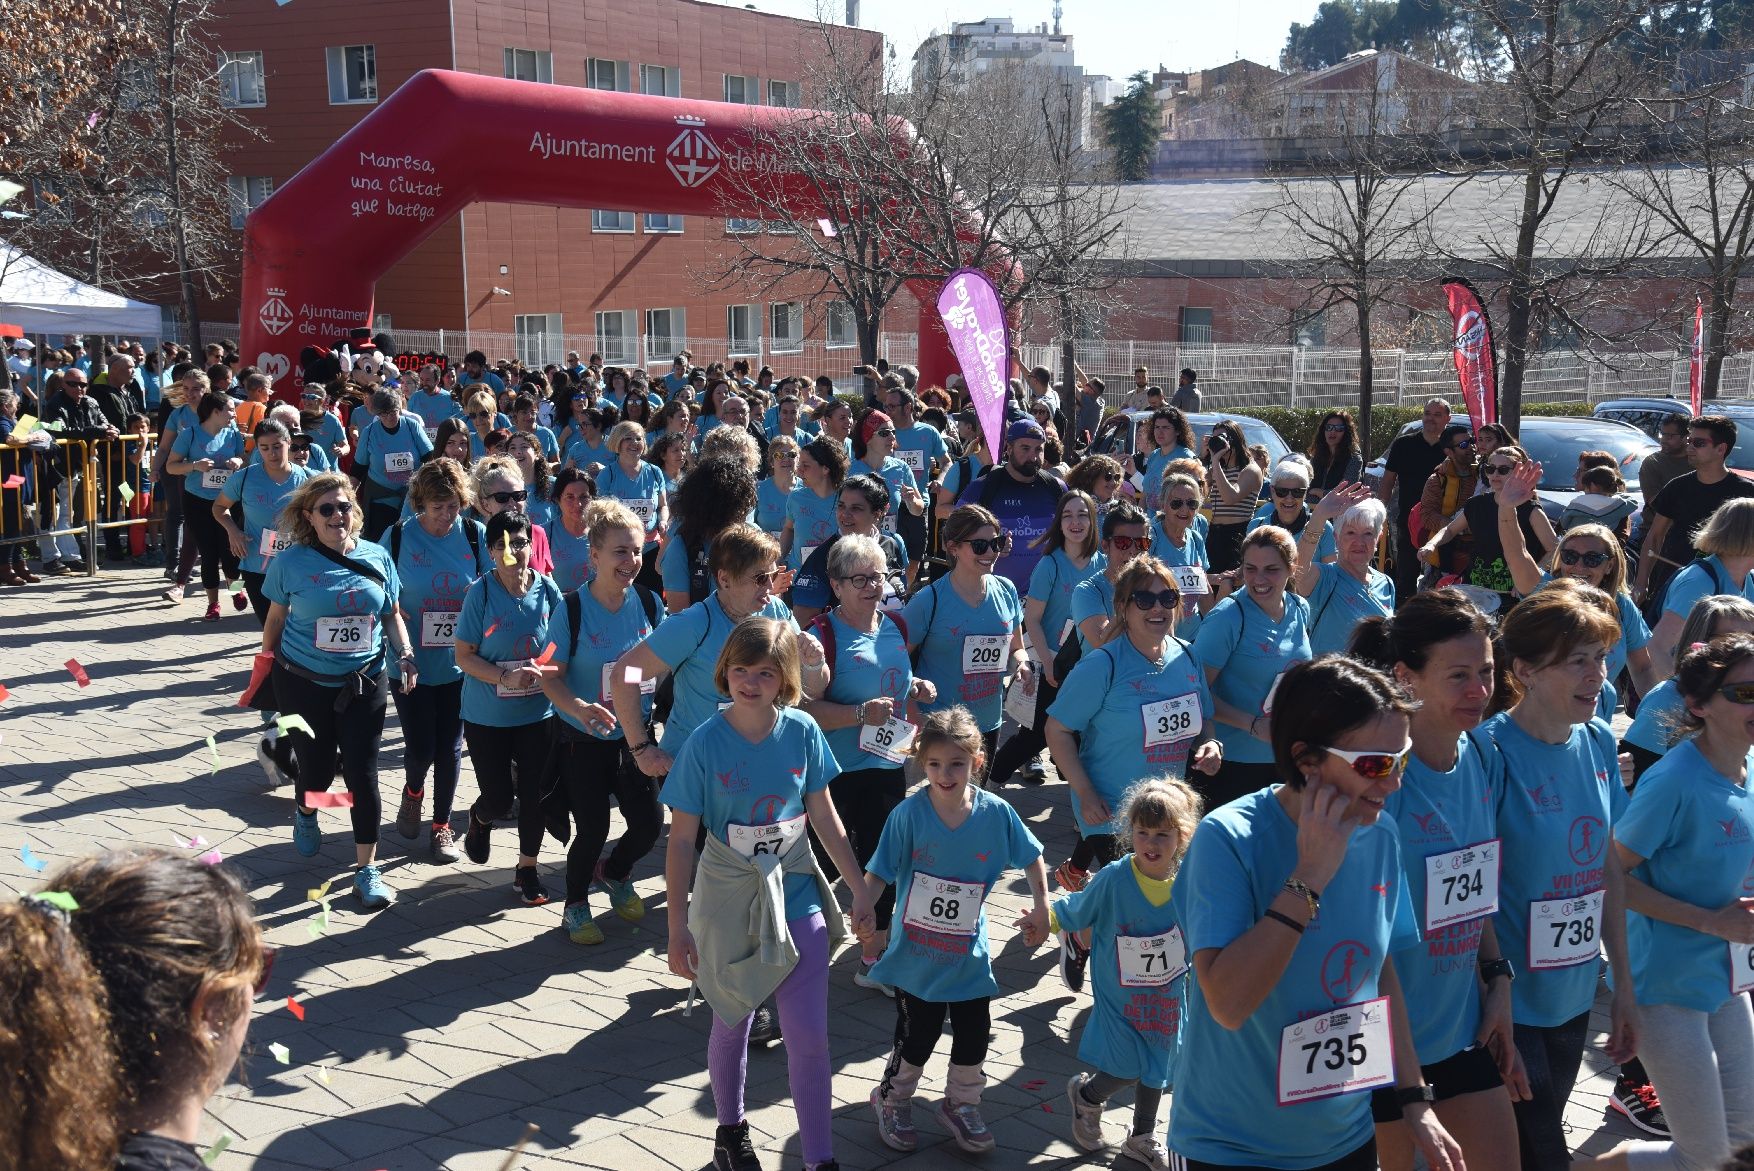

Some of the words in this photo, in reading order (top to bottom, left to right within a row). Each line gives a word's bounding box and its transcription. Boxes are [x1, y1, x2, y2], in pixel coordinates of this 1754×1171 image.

[529, 131, 656, 164] Ajuntament
[360, 151, 435, 174] Manresa,
[728, 150, 753, 172] de
[351, 176, 383, 191] una
[389, 176, 444, 197] ciutat
[351, 198, 379, 217] que
[387, 198, 435, 222] batega
[299, 303, 369, 322] Ajuntament
[298, 321, 317, 334] de
[391, 458, 408, 467] 169
[209, 474, 227, 484] 483
[1180, 575, 1200, 587] 137
[328, 627, 361, 643] 736
[971, 647, 1001, 663] 209
[1157, 711, 1191, 734] 338
[875, 727, 895, 747] 66
[753, 837, 785, 857] 67
[1441, 868, 1484, 906] 734
[1575, 868, 1605, 886] CURS
[929, 896, 960, 920] 68
[1550, 915, 1594, 948] 738
[1140, 950, 1169, 973] 71
[1301, 1032, 1367, 1074] 735
